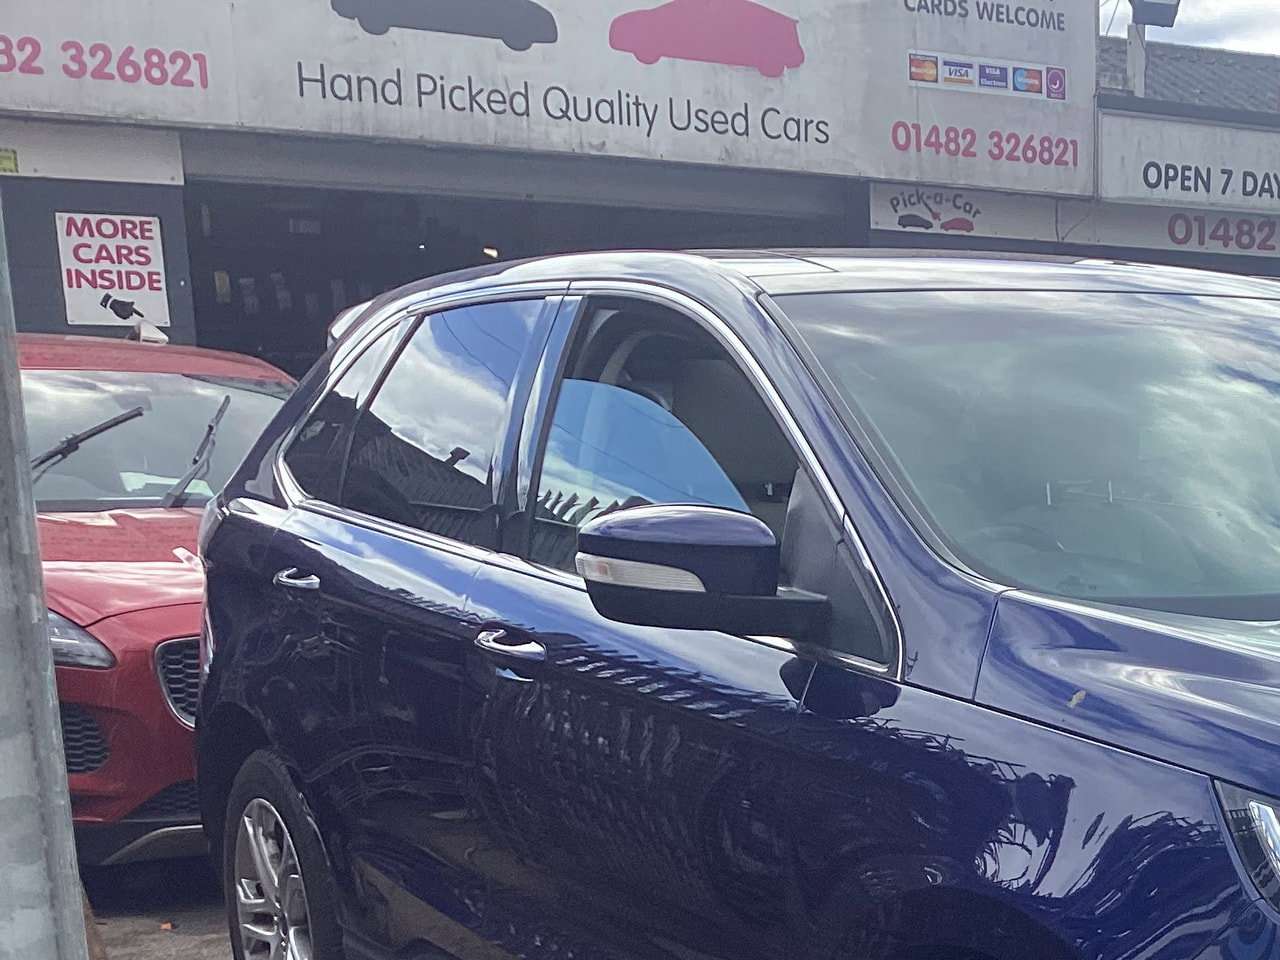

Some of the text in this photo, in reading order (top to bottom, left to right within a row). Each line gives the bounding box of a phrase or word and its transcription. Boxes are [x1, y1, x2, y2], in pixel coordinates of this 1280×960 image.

[904, 0, 1066, 31] CARDS WELCOME
[61, 40, 208, 89] 326821
[948, 67, 969, 78] VISA
[297, 61, 830, 144] Hand Picked Quality Used Cars
[891, 121, 1078, 167] 01482 326821
[1142, 161, 1212, 193] OPEN
[1220, 169, 1233, 195] 7
[890, 189, 983, 218] Pick-a-Car
[66, 217, 154, 240] MORE
[1168, 212, 1276, 251] 01482
[73, 243, 151, 266] CARS
[66, 268, 162, 291] INSIDE
